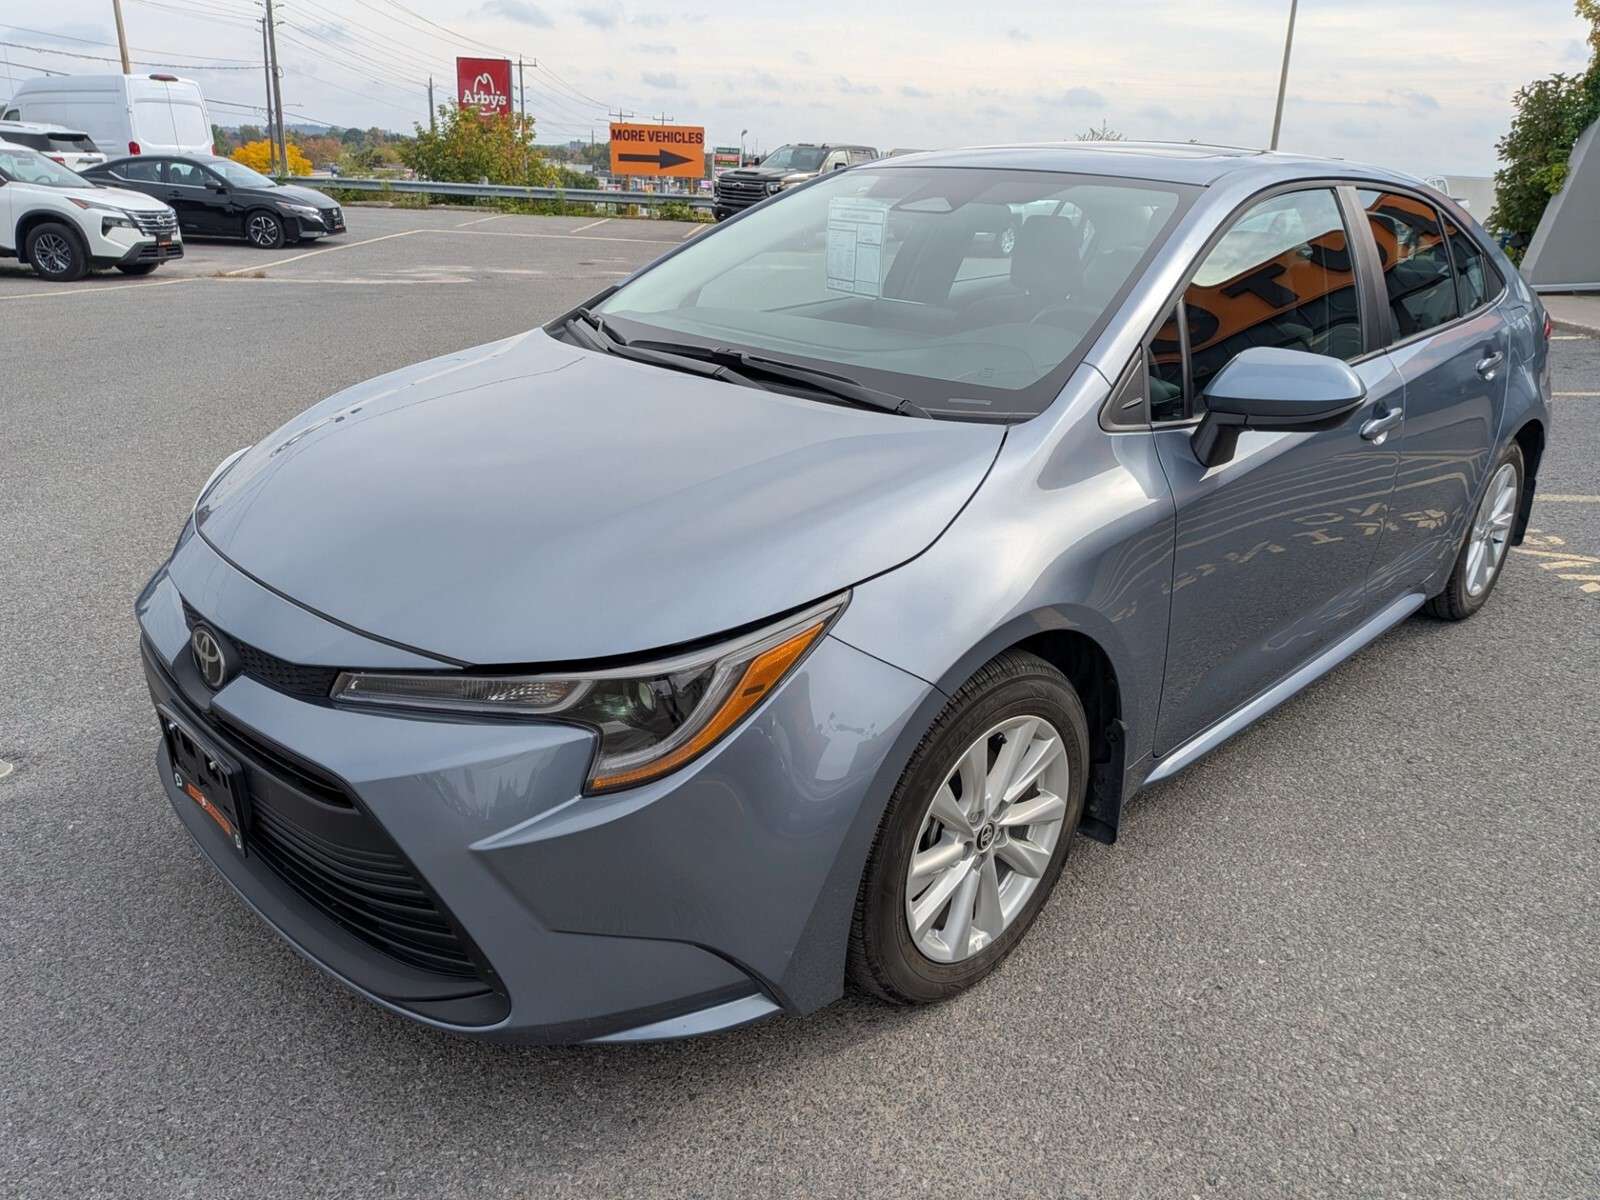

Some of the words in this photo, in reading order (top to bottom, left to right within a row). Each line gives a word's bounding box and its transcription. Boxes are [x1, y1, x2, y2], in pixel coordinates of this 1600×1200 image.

[462, 89, 507, 109] Arby's
[611, 129, 645, 142] MORE
[648, 131, 703, 144] VEHICLES
